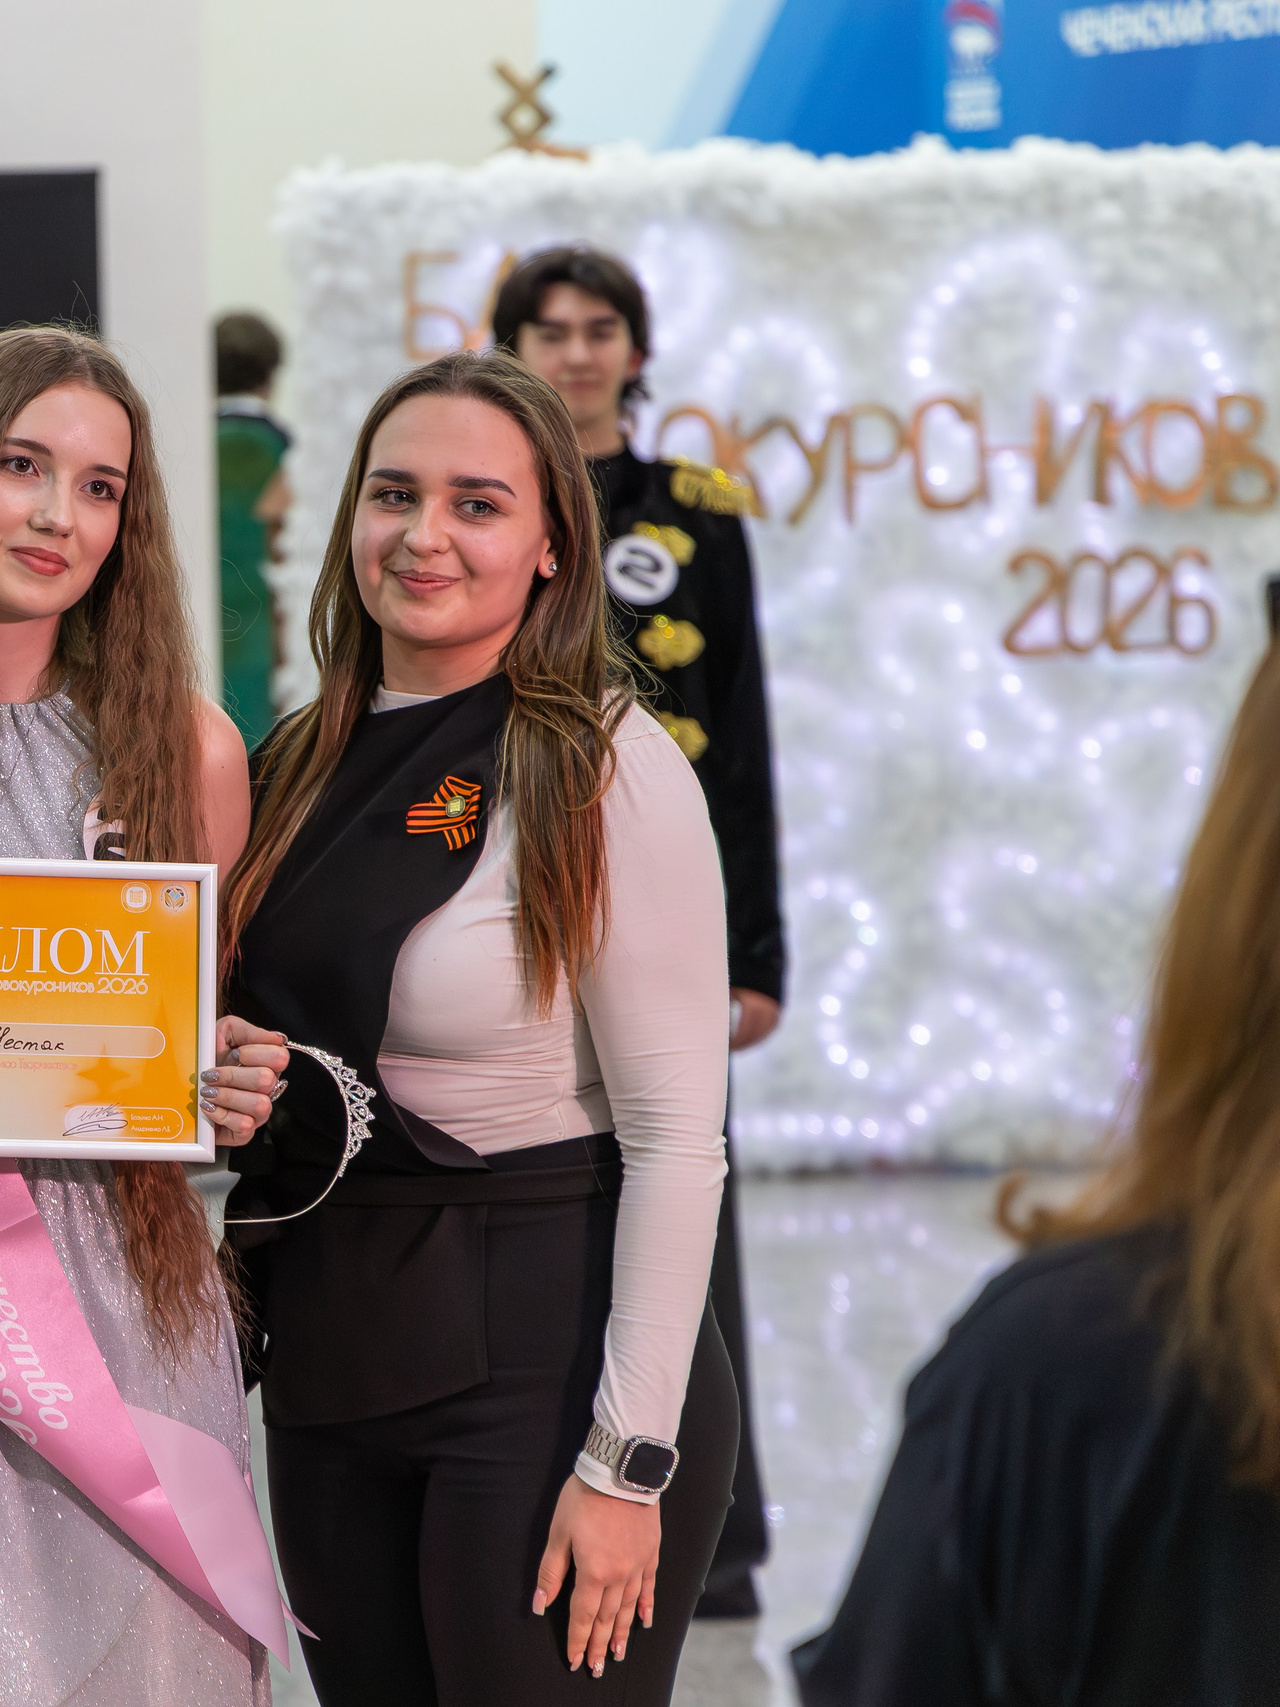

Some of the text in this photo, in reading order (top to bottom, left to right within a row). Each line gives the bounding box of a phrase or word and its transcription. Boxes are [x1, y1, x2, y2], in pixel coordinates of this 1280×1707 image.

[618, 546, 662, 590] 2
[1005, 546, 1218, 658] 2026
[97, 977, 149, 995] 2026
